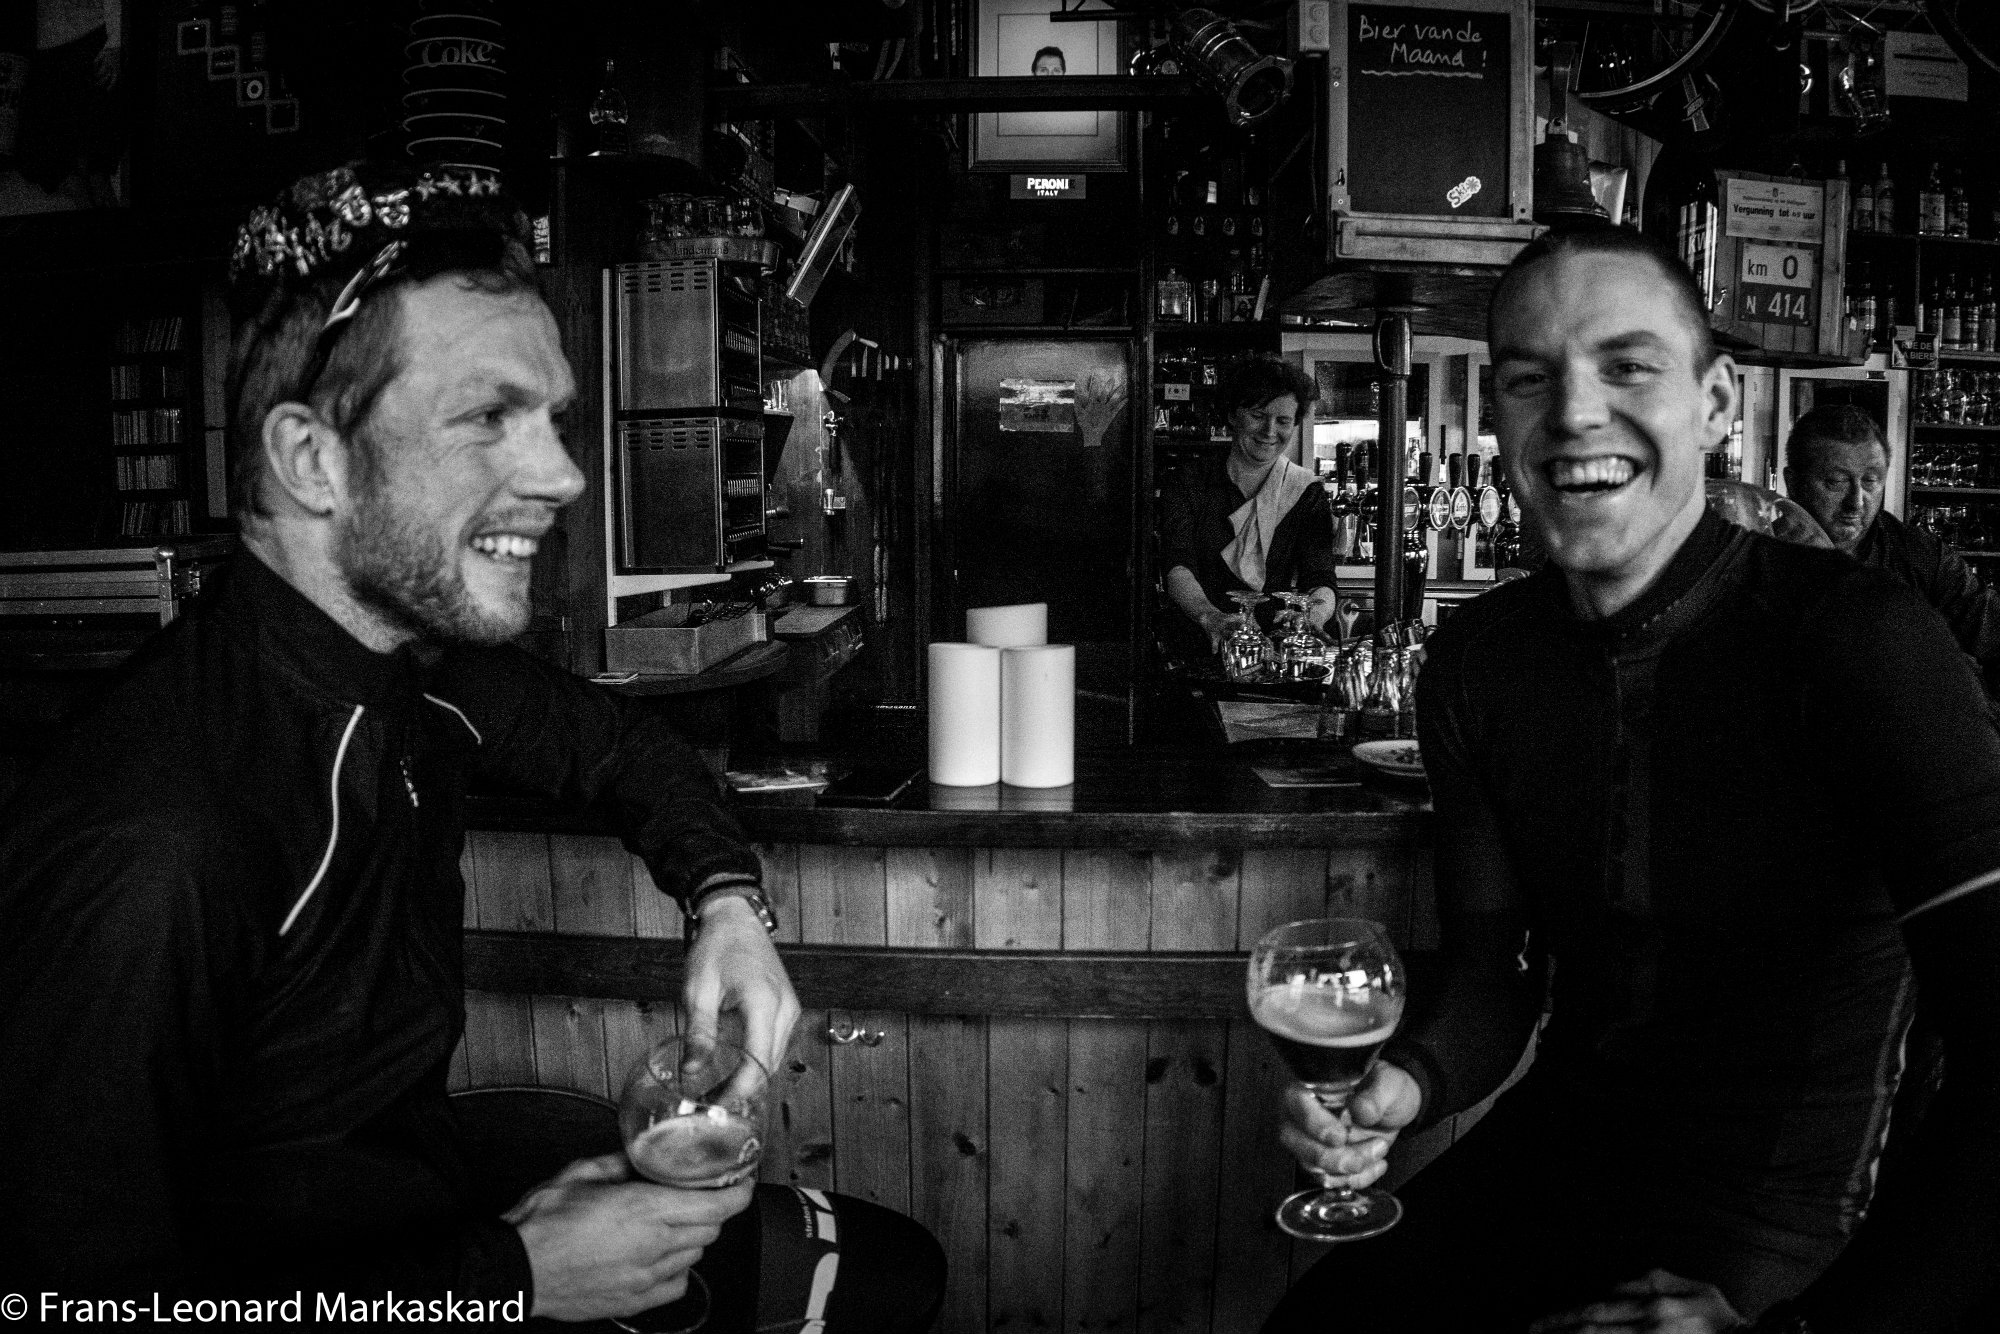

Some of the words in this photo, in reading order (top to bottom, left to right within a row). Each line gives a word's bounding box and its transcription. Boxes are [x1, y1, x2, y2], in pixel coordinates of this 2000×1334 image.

[1358, 14, 1406, 42] Bier
[1026, 177, 1069, 190] PERONI
[1036, 189, 1059, 197] ITALY
[1733, 203, 1774, 218] Vergunning
[1779, 208, 1790, 218] tot
[1803, 212, 1816, 220] uur
[1747, 258, 1768, 277] km
[1782, 254, 1799, 280] 0
[1746, 295, 1757, 315] N
[1767, 291, 1806, 320] 414
[1920, 341, 1932, 351] DE
